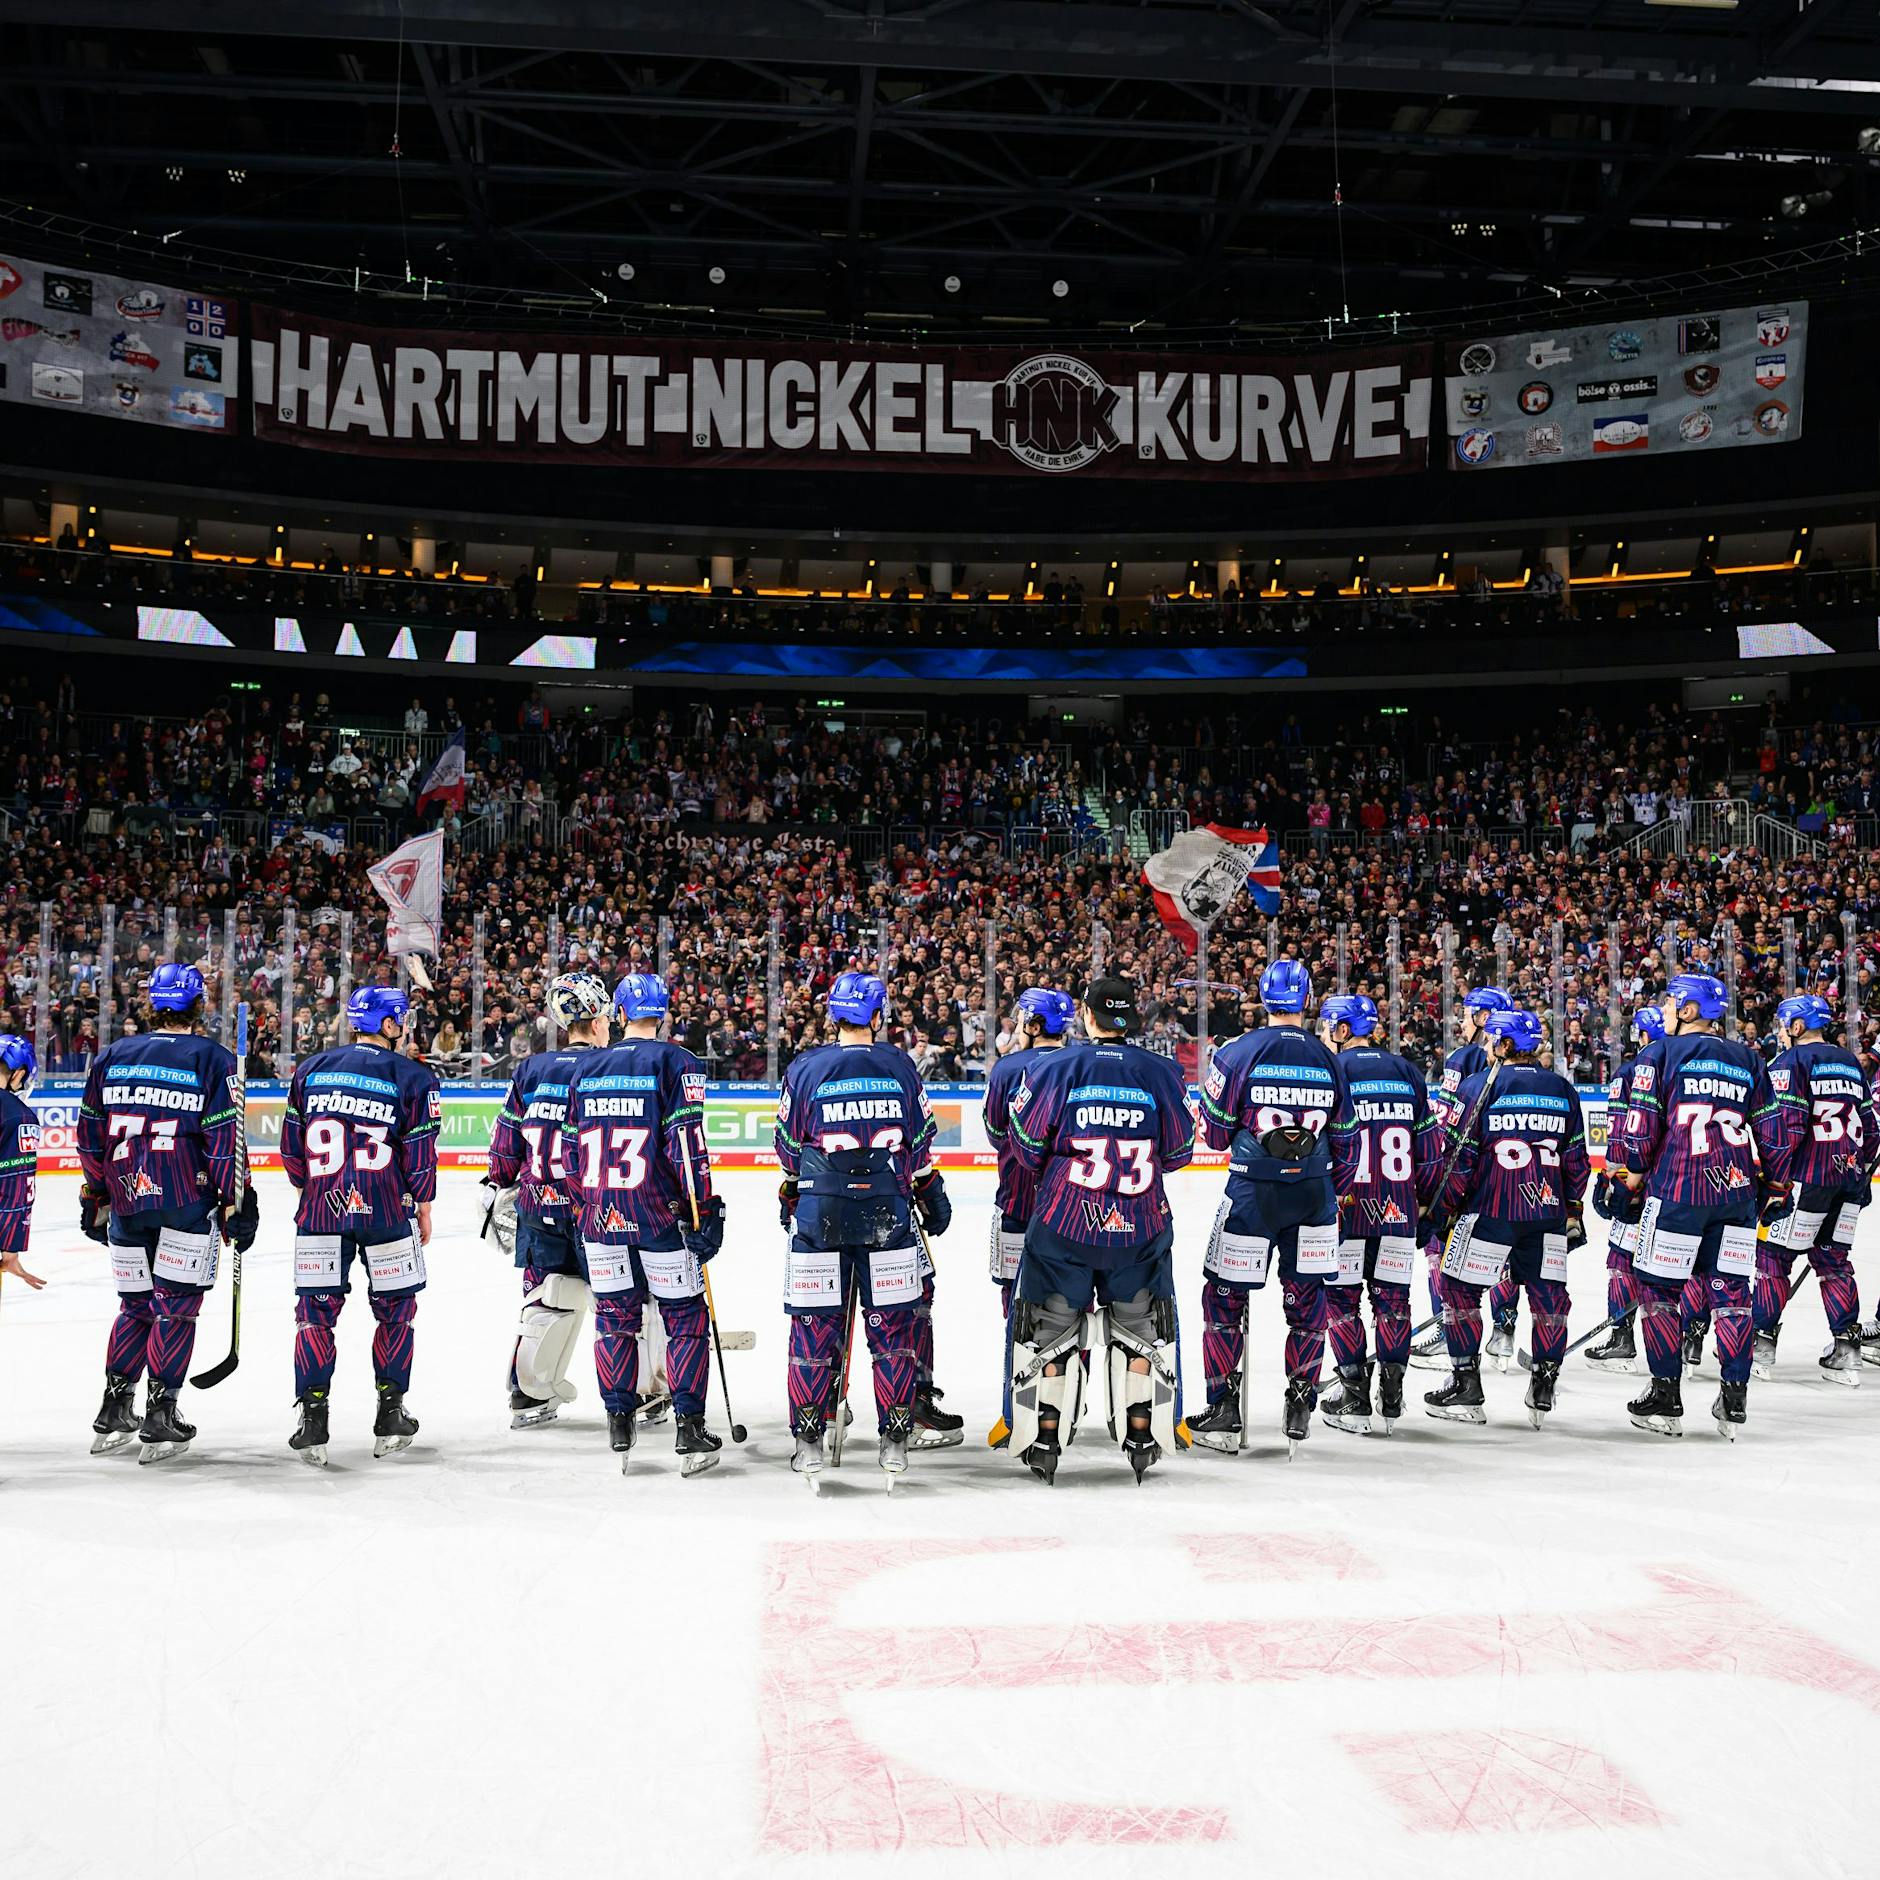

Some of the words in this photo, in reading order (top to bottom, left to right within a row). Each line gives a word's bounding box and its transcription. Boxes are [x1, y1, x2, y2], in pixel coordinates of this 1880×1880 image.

[1013, 361, 1043, 384] HARTMUT
[1046, 360, 1071, 371] NICKEL
[1073, 366, 1097, 386] KURVE
[278, 329, 661, 447] HARTMUT
[693, 356, 972, 454] NICKEL
[1138, 365, 1401, 463] KURVE
[992, 378, 1120, 452] HNK
[1025, 448, 1045, 464] HABE
[1048, 457, 1061, 466] DIE
[1064, 451, 1085, 465] EHRE
[1096, 1051, 1123, 1059] structure
[160, 1071, 196, 1083] STROM
[1256, 1065, 1297, 1077] EISBÄREN
[314, 1074, 356, 1085] EISBÄREN
[440, 1081, 475, 1089] ASAG
[623, 1078, 654, 1088] STROM
[1119, 1090, 1147, 1101] STRO
[1350, 1083, 1378, 1093] BÄREN
[1250, 1085, 1335, 1107] GRENIER
[306, 1090, 396, 1125] PFÖDERL
[524, 1101, 567, 1120] NCIC
[584, 1097, 644, 1117] REGIN
[822, 1099, 903, 1123] MAUER
[441, 1116, 477, 1134] MIT
[1076, 1107, 1145, 1130] QUAPP
[108, 1113, 178, 1162] 71
[306, 1119, 393, 1178] 93
[1353, 1127, 1412, 1183] 18
[580, 1127, 650, 1189] 13
[1068, 1138, 1153, 1195] 33
[1635, 1199, 1654, 1263] CONTIPARK
[1839, 1223, 1854, 1231] BERLIN
[158, 1253, 183, 1265] BERLIN
[1223, 1257, 1248, 1266] BERLIN
[1655, 1254, 1680, 1264] BERLIN
[1724, 1250, 1747, 1260] BERLIN
[373, 1266, 400, 1276] BERLIN
[1380, 1259, 1404, 1268] BERLIN
[1466, 1262, 1489, 1271] BERLIN
[876, 1279, 903, 1288] BERLIN
